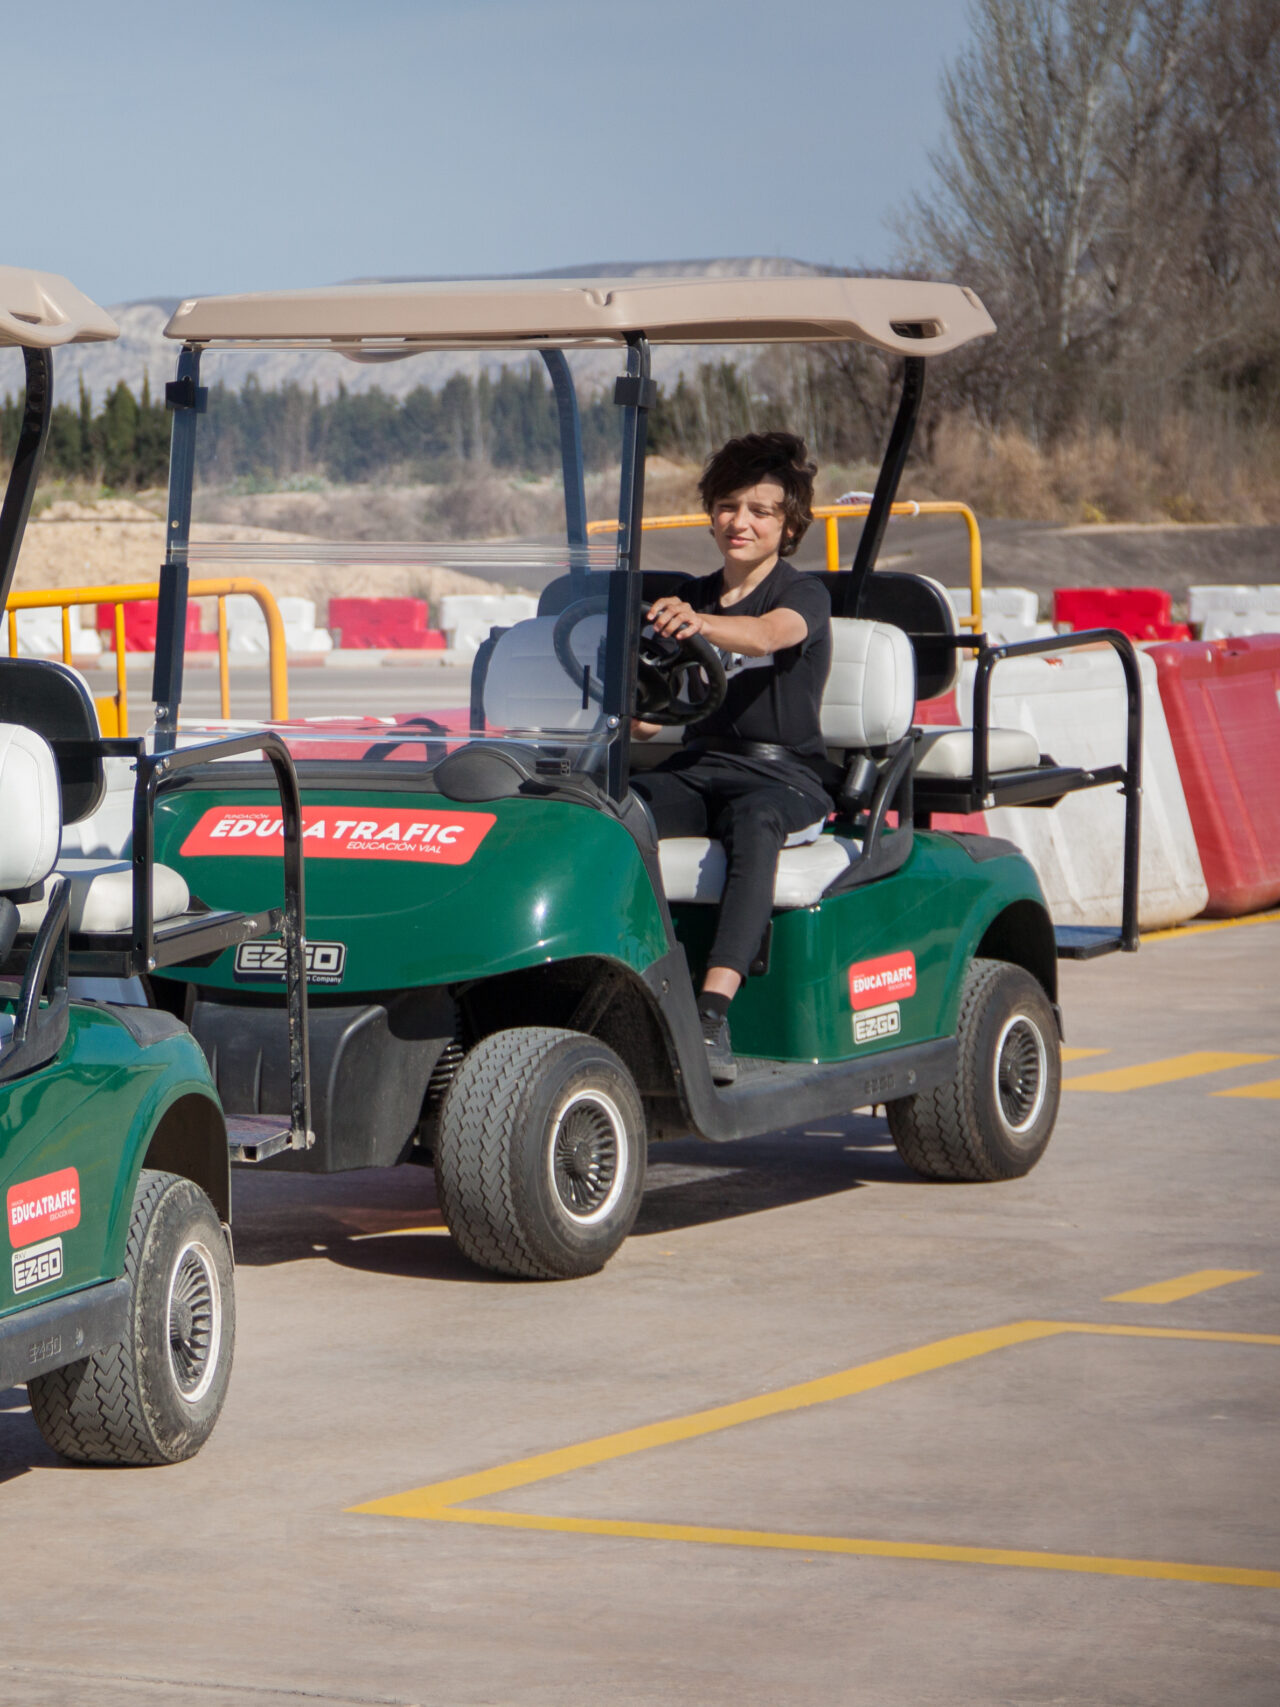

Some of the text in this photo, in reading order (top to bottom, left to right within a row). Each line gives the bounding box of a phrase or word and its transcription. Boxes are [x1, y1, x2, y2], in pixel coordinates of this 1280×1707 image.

[346, 840, 442, 853] EDUCACIÓN VIAL
[312, 975, 342, 983] Company
[853, 966, 913, 994] EDUCATRAFIC
[11, 1188, 76, 1226] EDUCATRAFIC
